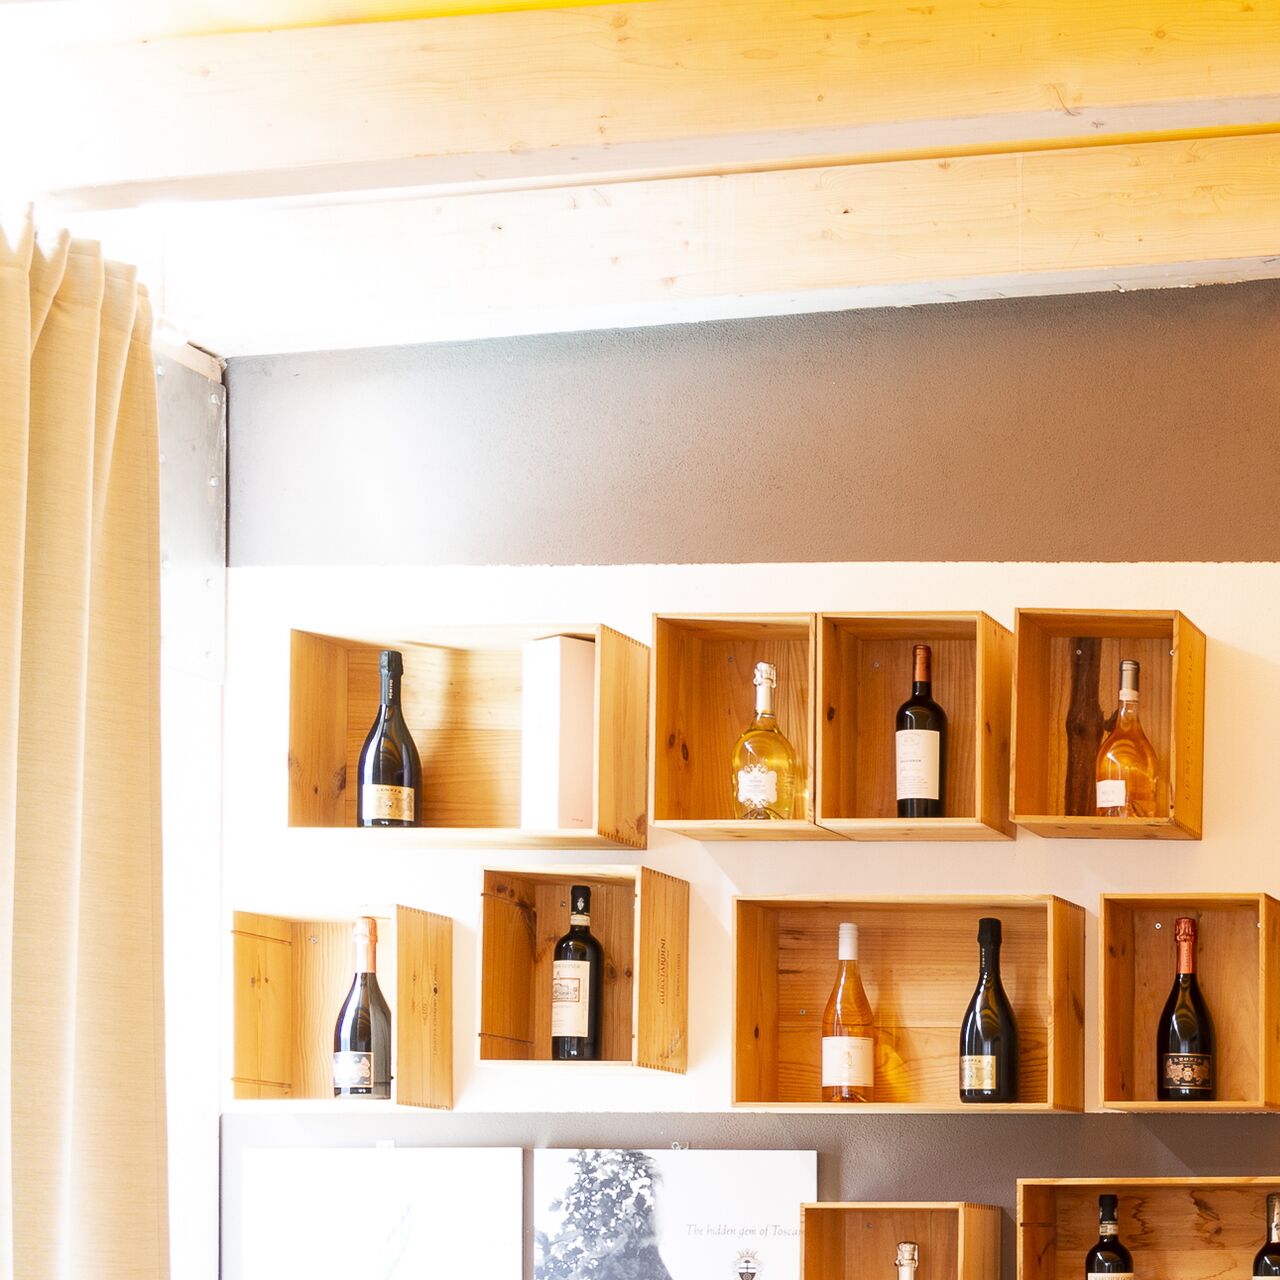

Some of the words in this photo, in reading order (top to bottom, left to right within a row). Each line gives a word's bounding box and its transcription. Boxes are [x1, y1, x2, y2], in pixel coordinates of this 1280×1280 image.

[686, 1223, 704, 1236] The
[706, 1223, 736, 1236] hidden
[738, 1227, 757, 1239] gem
[759, 1222, 770, 1239] of
